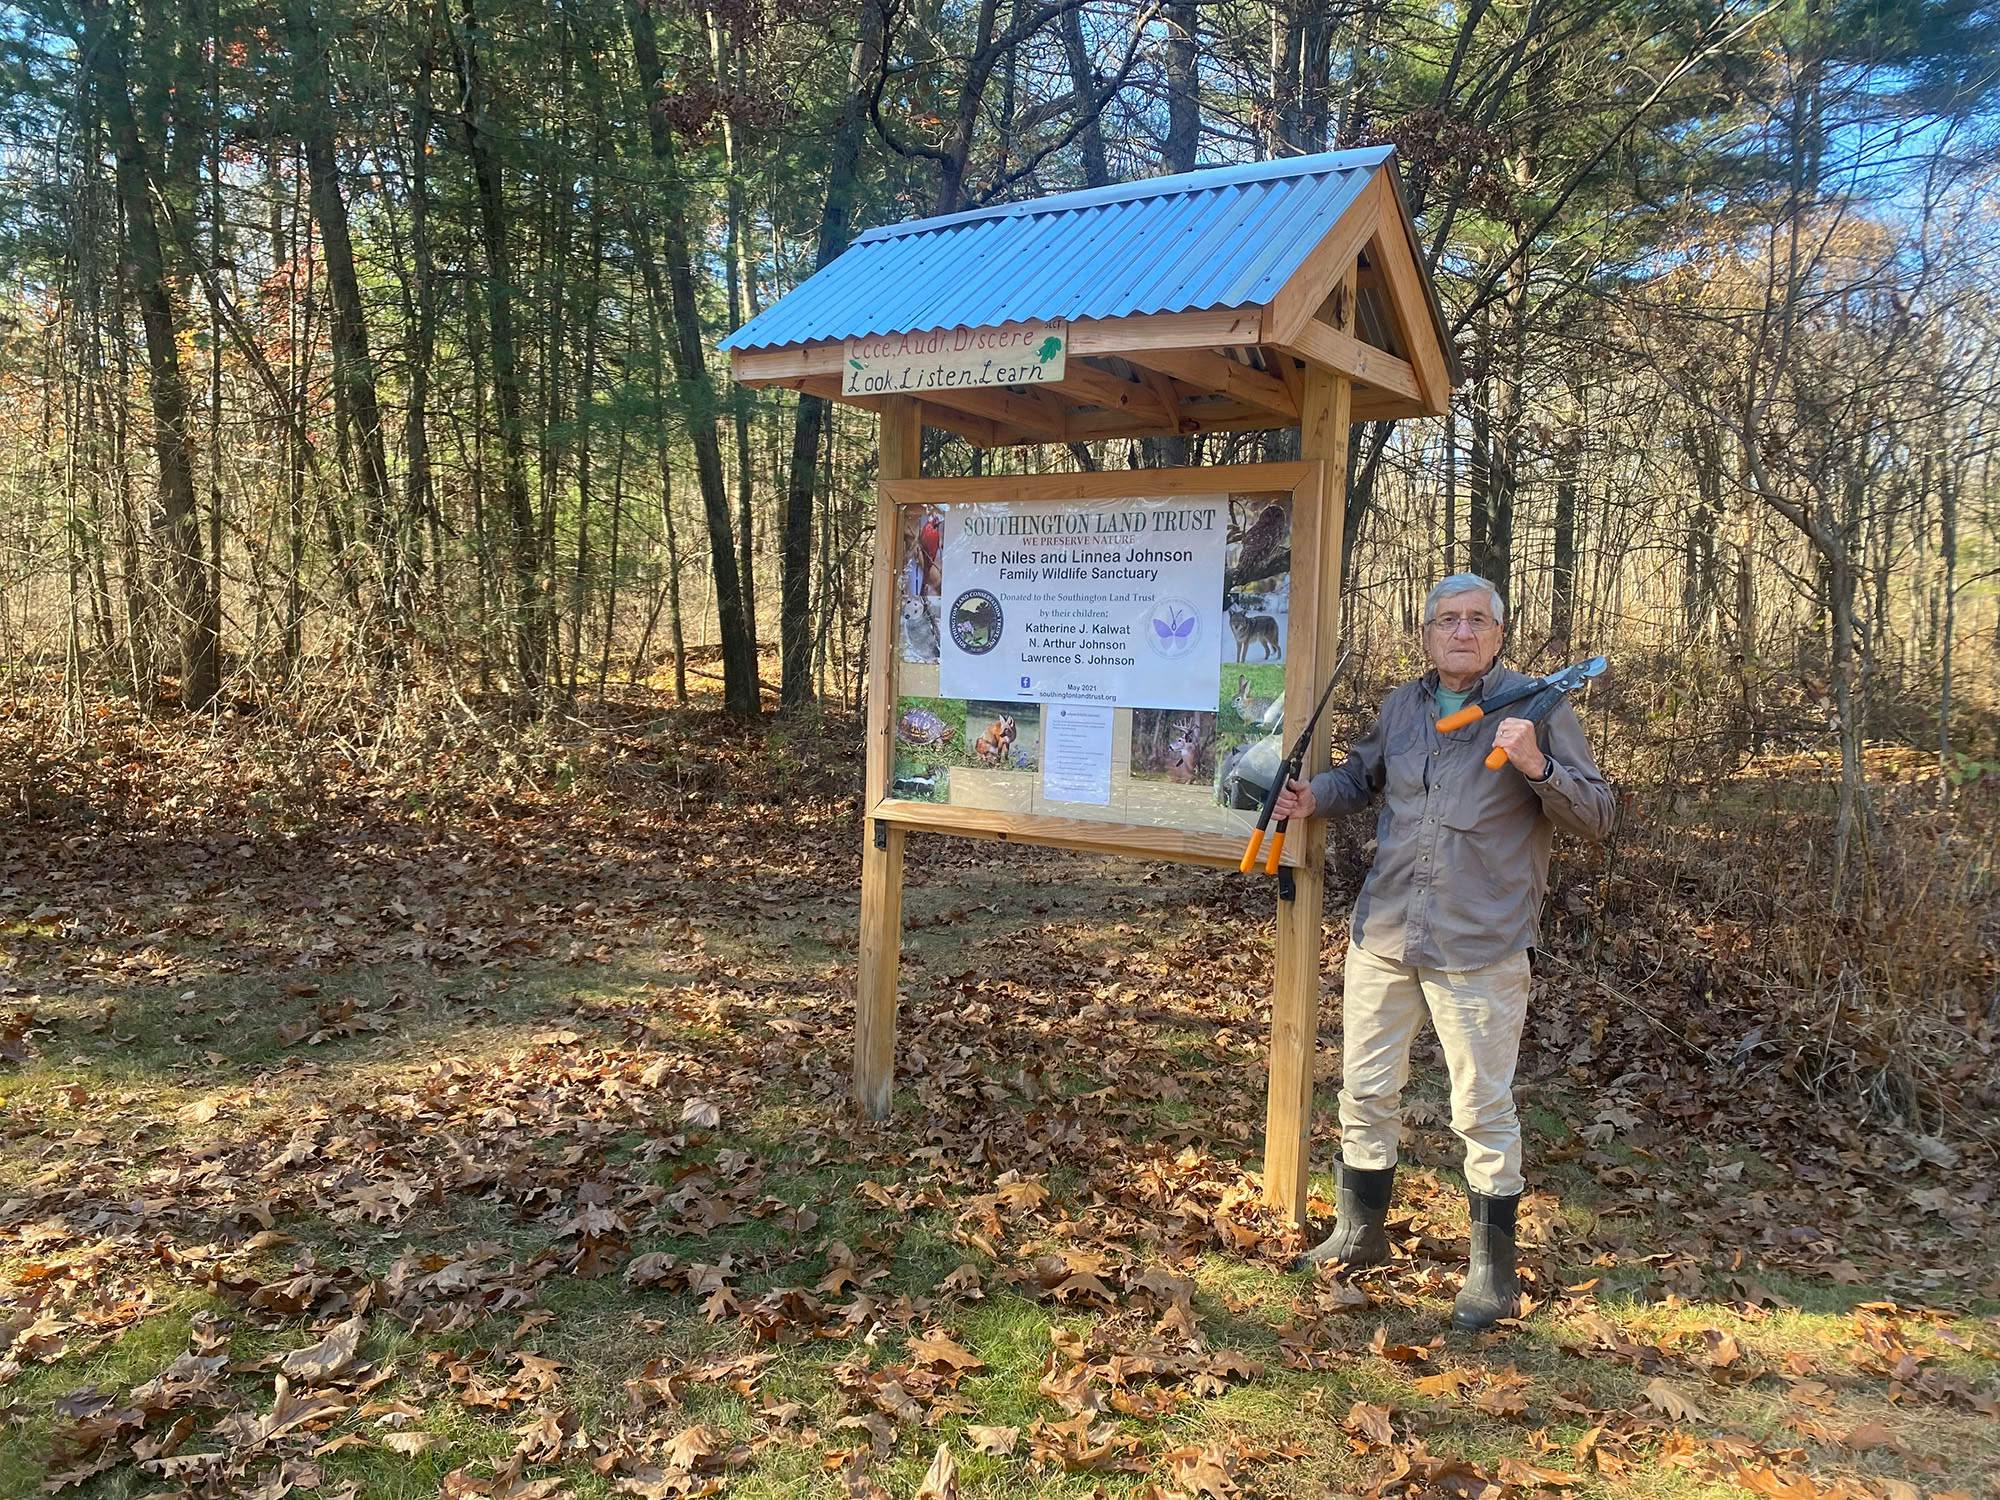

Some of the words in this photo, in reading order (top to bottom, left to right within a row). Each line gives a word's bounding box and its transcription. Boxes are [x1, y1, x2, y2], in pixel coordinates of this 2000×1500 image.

[979, 360, 1044, 385] Learn
[964, 513, 1090, 537] SOUTHINGTON
[1096, 512, 1147, 534] LAND
[1152, 509, 1216, 531] TRUST
[1022, 537, 1039, 546] WE
[1040, 536, 1090, 546] PRESERVE
[1092, 535, 1135, 545] NATURE
[972, 551, 997, 565] The
[1001, 551, 1036, 564] Niles
[1040, 549, 1067, 563] and
[1072, 549, 1121, 563] Linnea
[1126, 548, 1193, 563] Johnson
[1000, 568, 1039, 583] Family
[1042, 567, 1087, 580] Wildlife
[1091, 566, 1158, 582] Sanctuary
[1000, 592, 1032, 601] Donated
[1034, 593, 1042, 601] to
[1043, 593, 1056, 601] the
[1058, 593, 1107, 604] Southington
[1109, 593, 1130, 601] Land
[1132, 593, 1155, 602] Trust
[1039, 608, 1049, 619] by
[1052, 609, 1071, 618] their
[1025, 623, 1076, 634] Katherine
[1079, 624, 1088, 634] J.
[1092, 624, 1131, 635] Kalwat
[1029, 638, 1040, 648] N.
[1042, 638, 1076, 649] Arthur
[1079, 639, 1126, 650] Johnson
[1021, 653, 1071, 664] Lawrence
[1074, 654, 1085, 664] S.
[1087, 655, 1135, 666] Johnson
[1067, 684, 1080, 692] May
[1082, 684, 1097, 692] 2021
[1040, 691, 1117, 702] southingtonlandtrust.org
